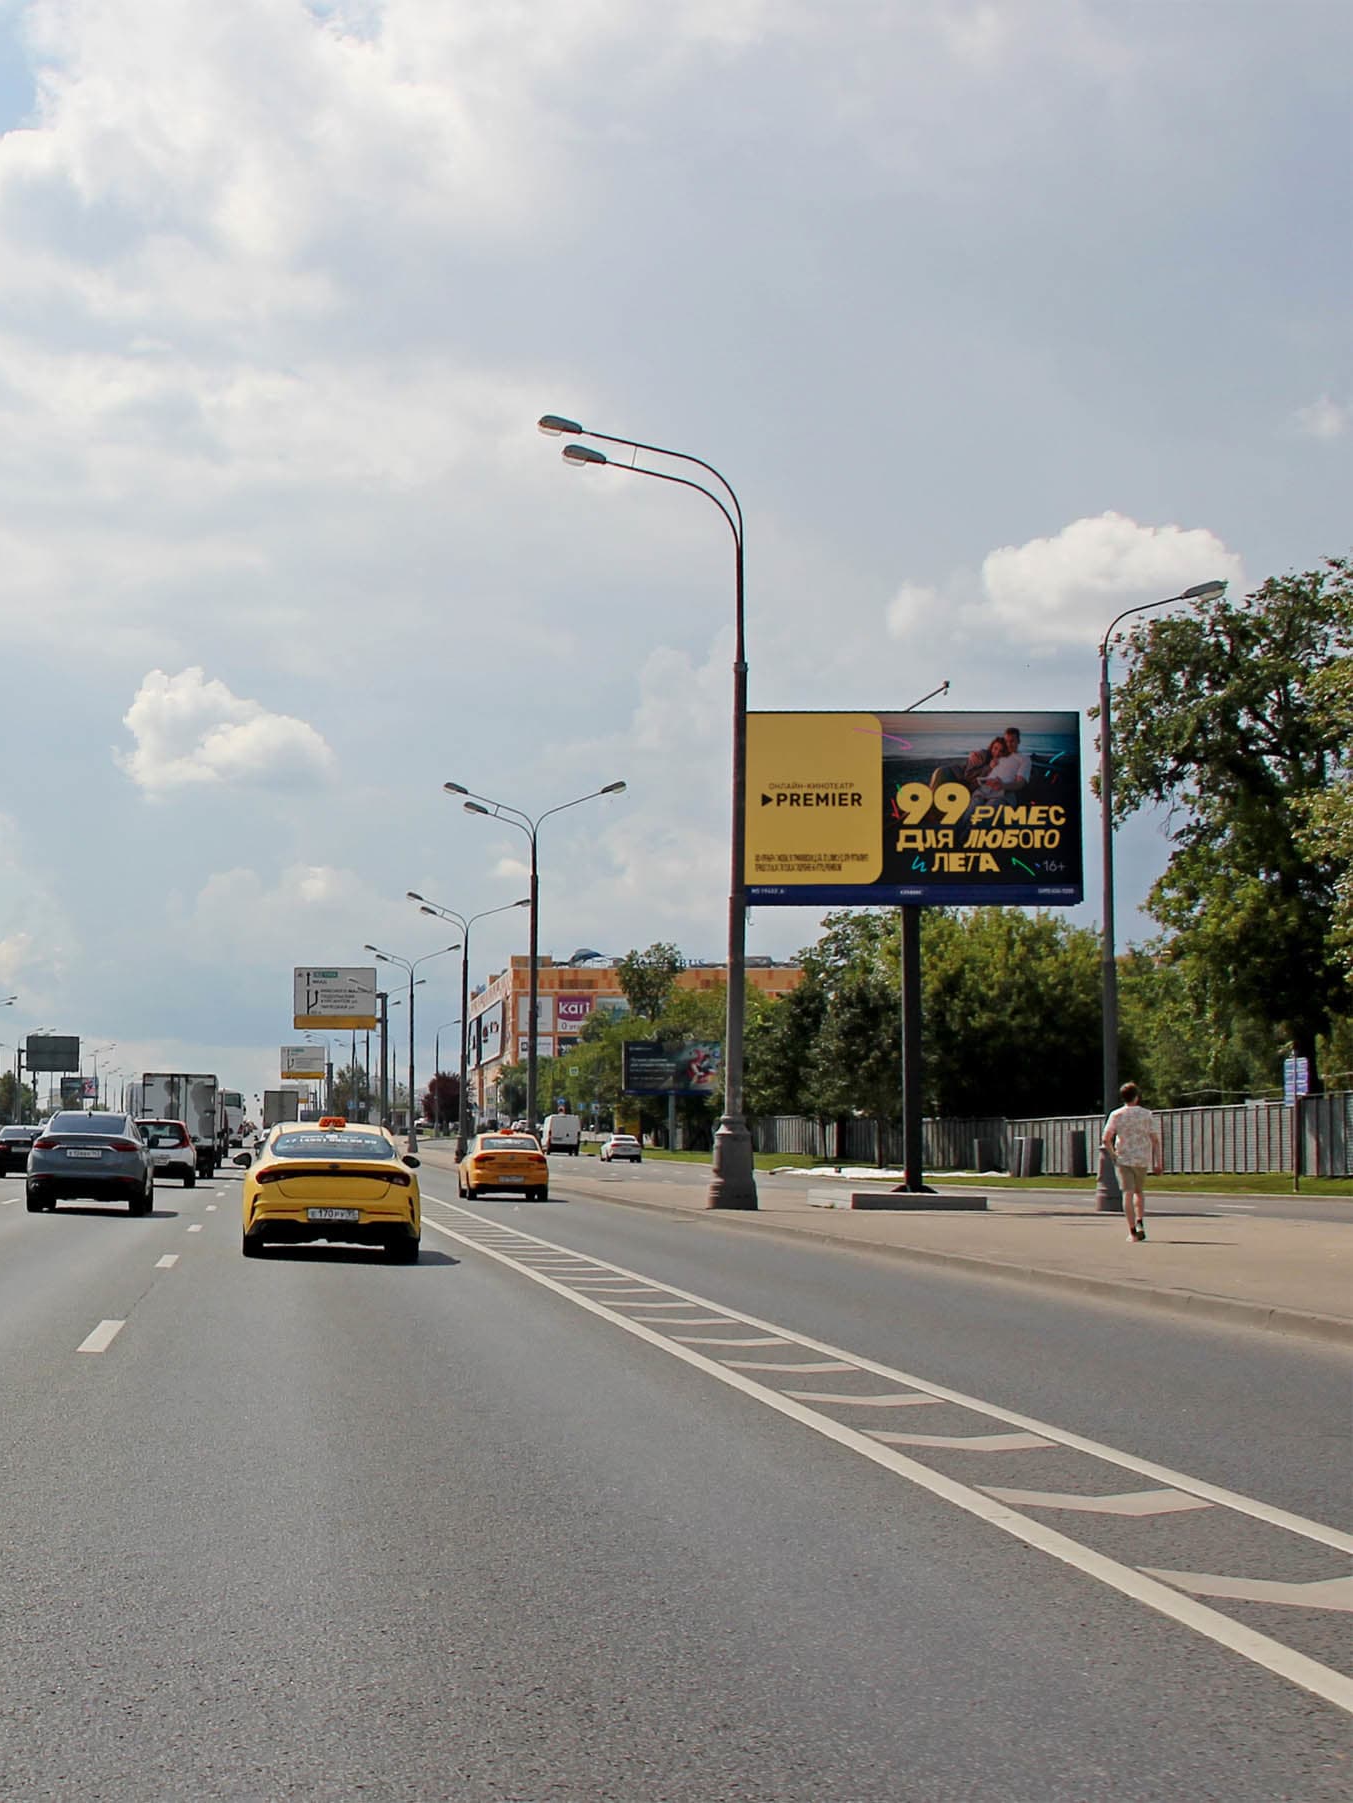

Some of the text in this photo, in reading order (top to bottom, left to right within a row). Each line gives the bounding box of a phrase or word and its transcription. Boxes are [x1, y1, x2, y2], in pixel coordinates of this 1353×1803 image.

[776, 792, 862, 807] PREMIER
[896, 782, 971, 825] 99
[896, 829, 1061, 852] ДЛЯ ЛЮБОГО
[931, 852, 1000, 872] ЛЕТА
[1043, 860, 1066, 872] 16+
[559, 1002, 590, 1014] kari
